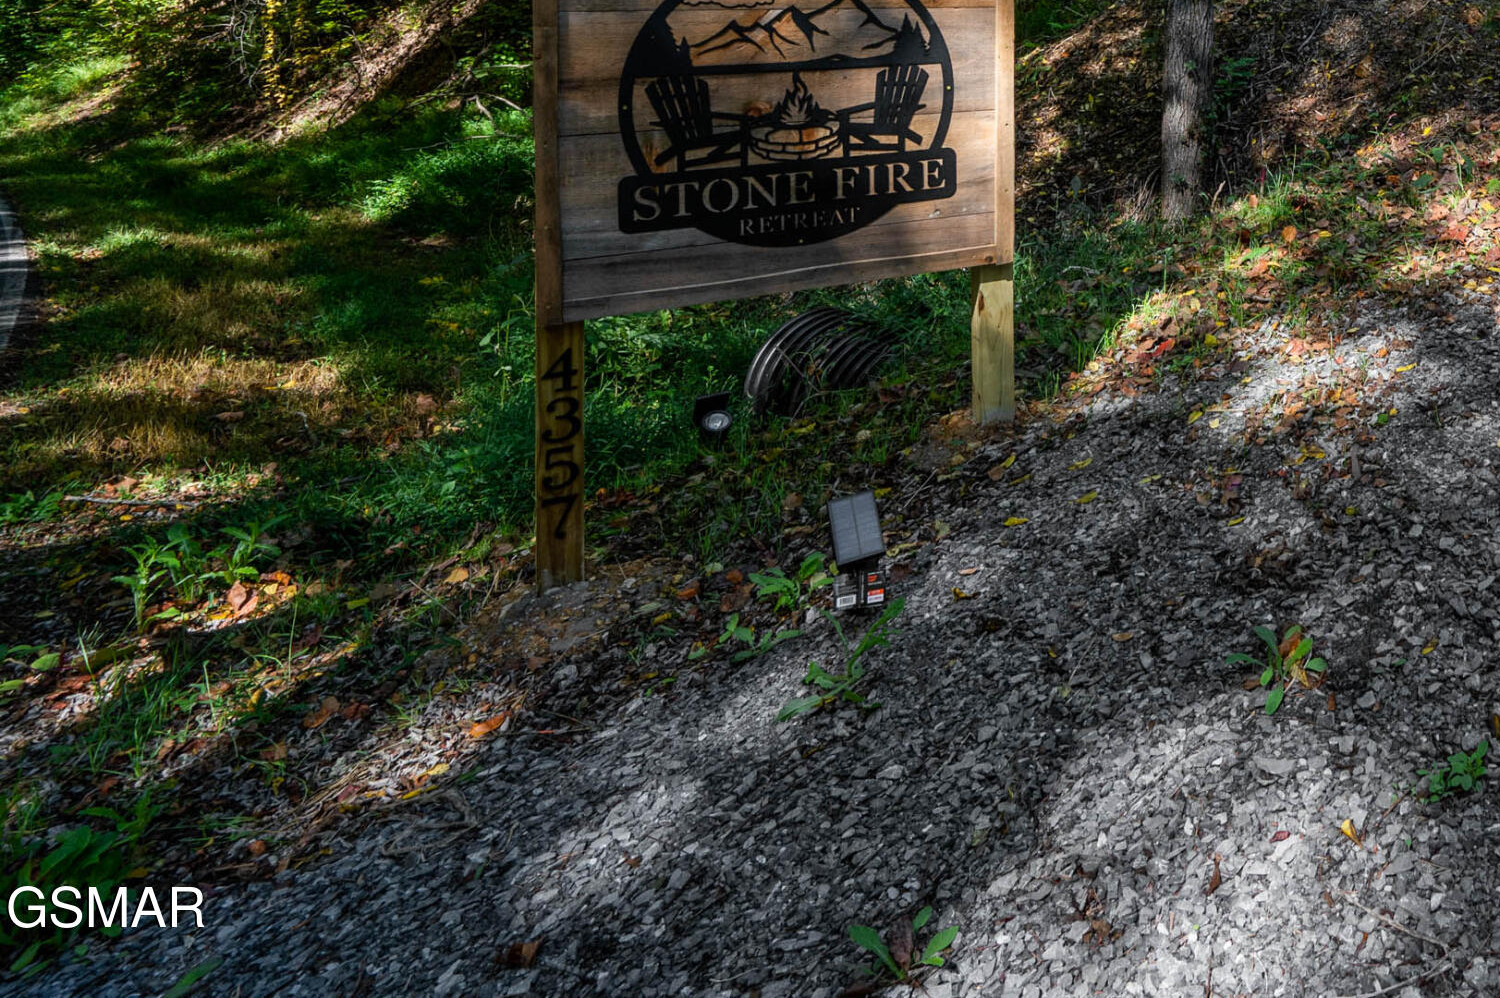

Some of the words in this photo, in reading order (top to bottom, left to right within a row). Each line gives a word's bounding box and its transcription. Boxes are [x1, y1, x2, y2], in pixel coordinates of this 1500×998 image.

[633, 172, 815, 221] STONE
[833, 158, 946, 199] FIRE
[739, 207, 859, 236] RETREAT
[541, 347, 581, 539] 4357
